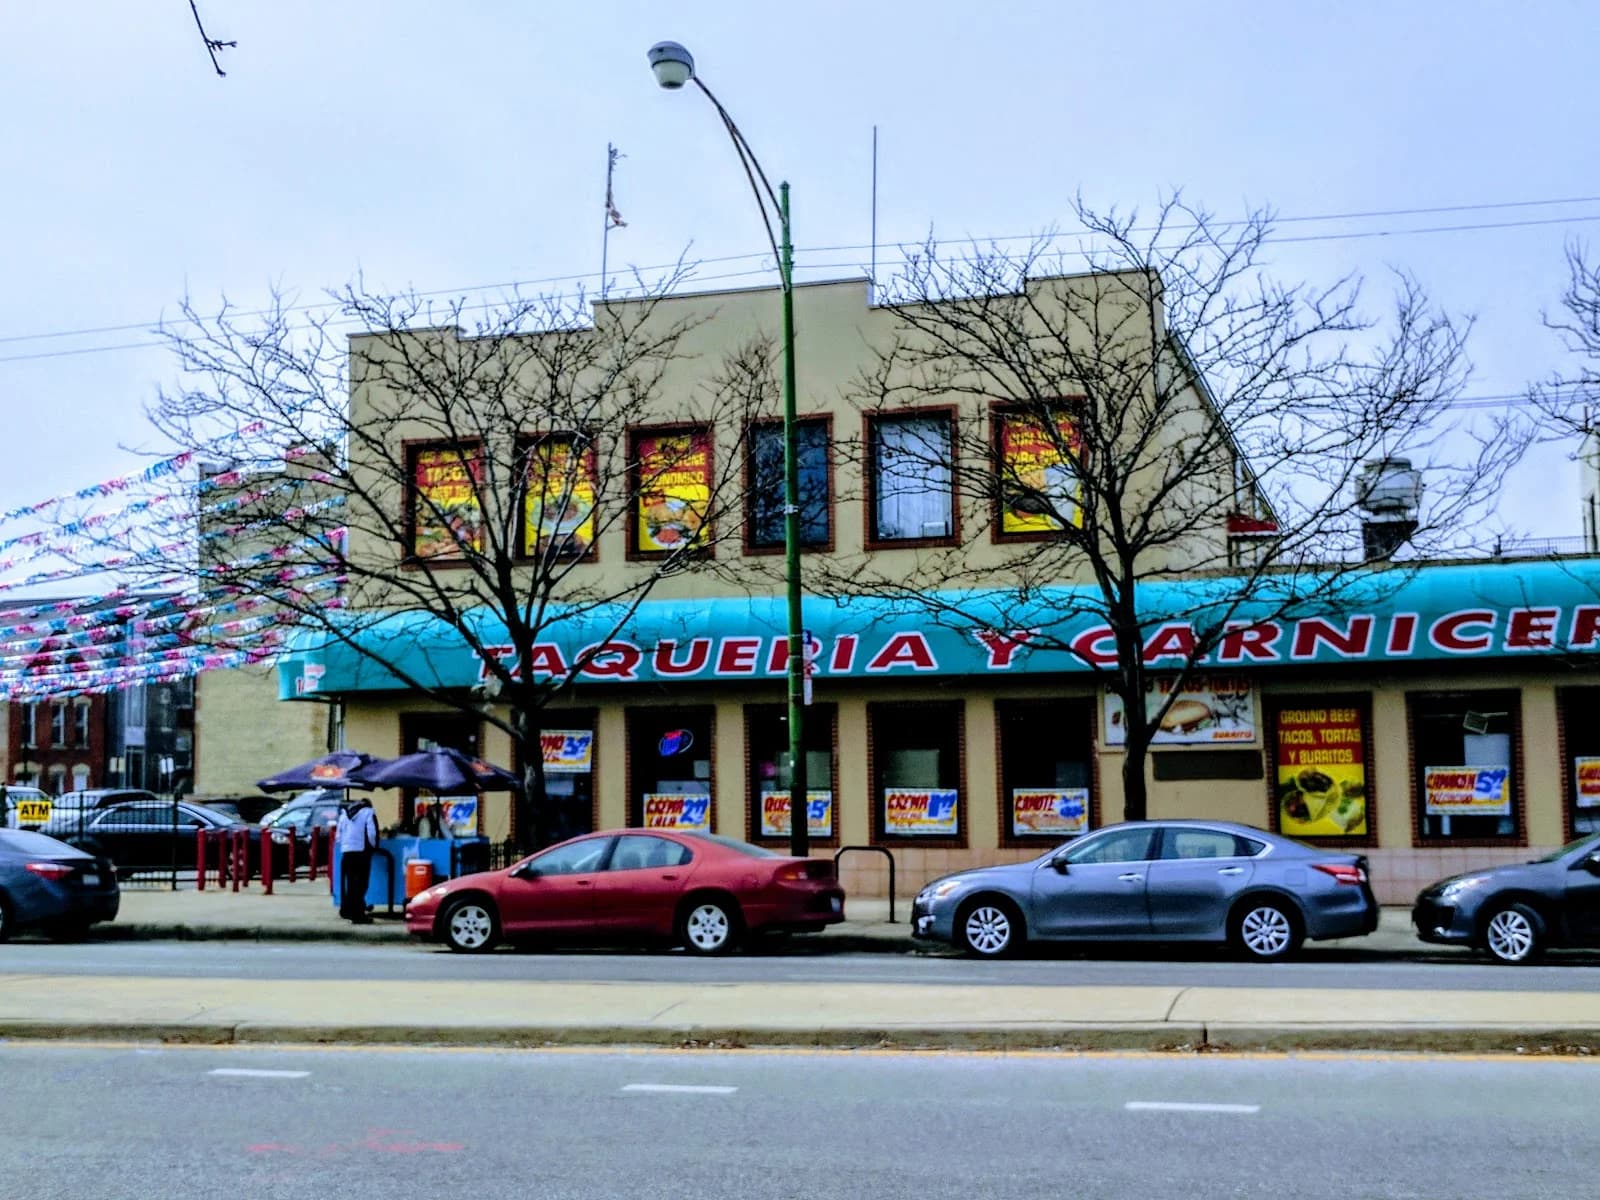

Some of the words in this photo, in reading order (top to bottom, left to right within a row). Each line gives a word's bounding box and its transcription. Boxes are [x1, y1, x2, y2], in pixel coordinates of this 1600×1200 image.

[472, 631, 938, 682] TAQUERIA
[971, 628, 1041, 669] Y
[1280, 710, 1327, 724] GROUND
[1329, 709, 1357, 722] BEEF
[1319, 728, 1361, 743] TORTAS
[1288, 750, 1296, 764] Y
[1299, 749, 1353, 764] BURRITOS
[20, 803, 50, 817] ATM
